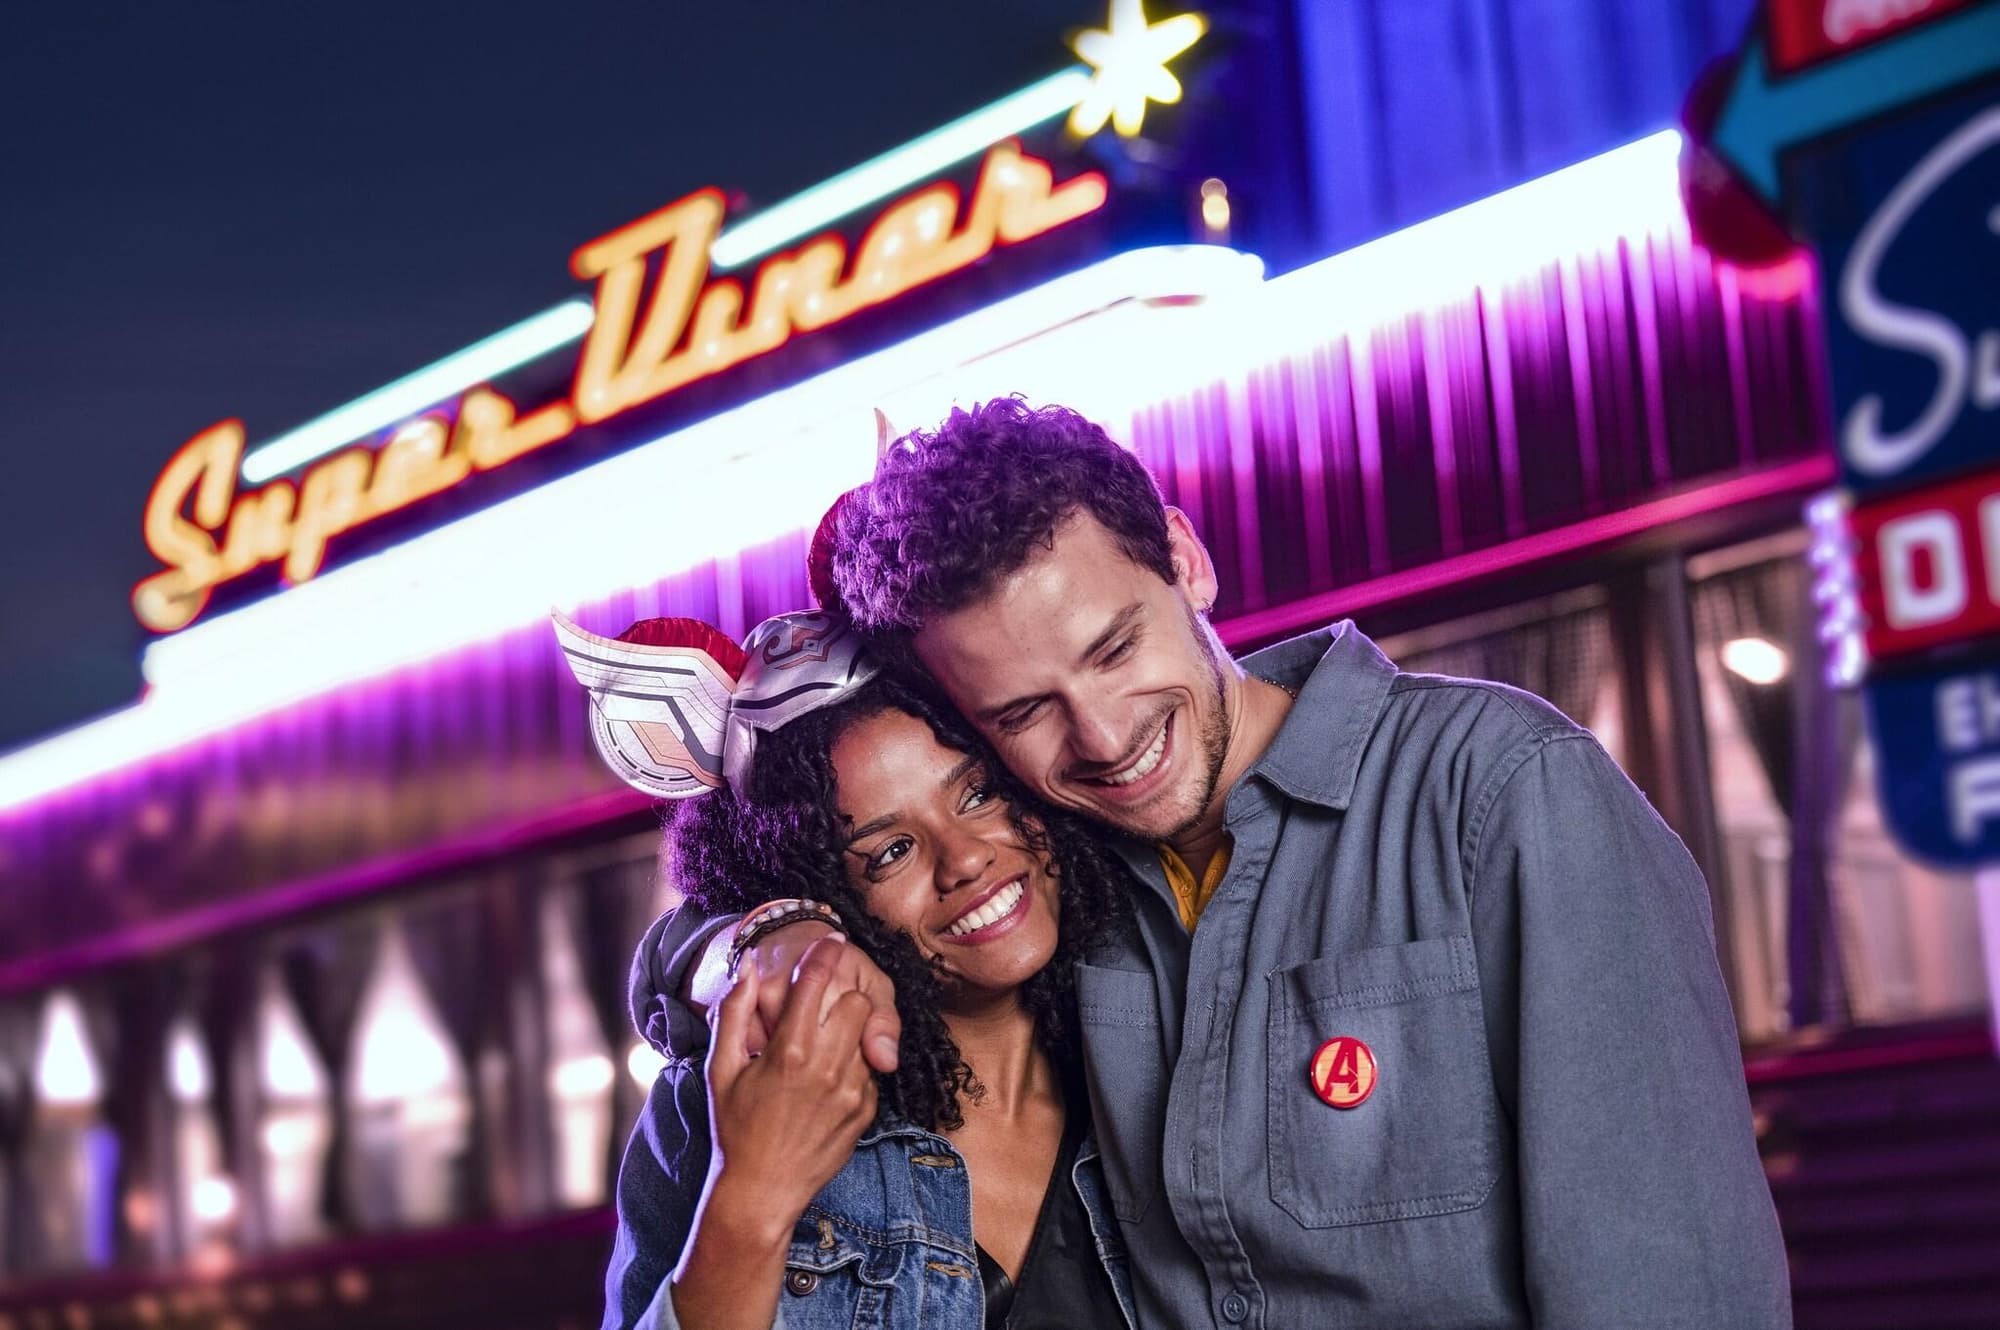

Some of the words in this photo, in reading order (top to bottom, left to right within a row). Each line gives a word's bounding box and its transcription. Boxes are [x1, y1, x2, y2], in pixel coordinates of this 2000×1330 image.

[132, 380, 576, 633] Super
[570, 139, 1107, 424] Diner
[1320, 1038, 1361, 1102] A
